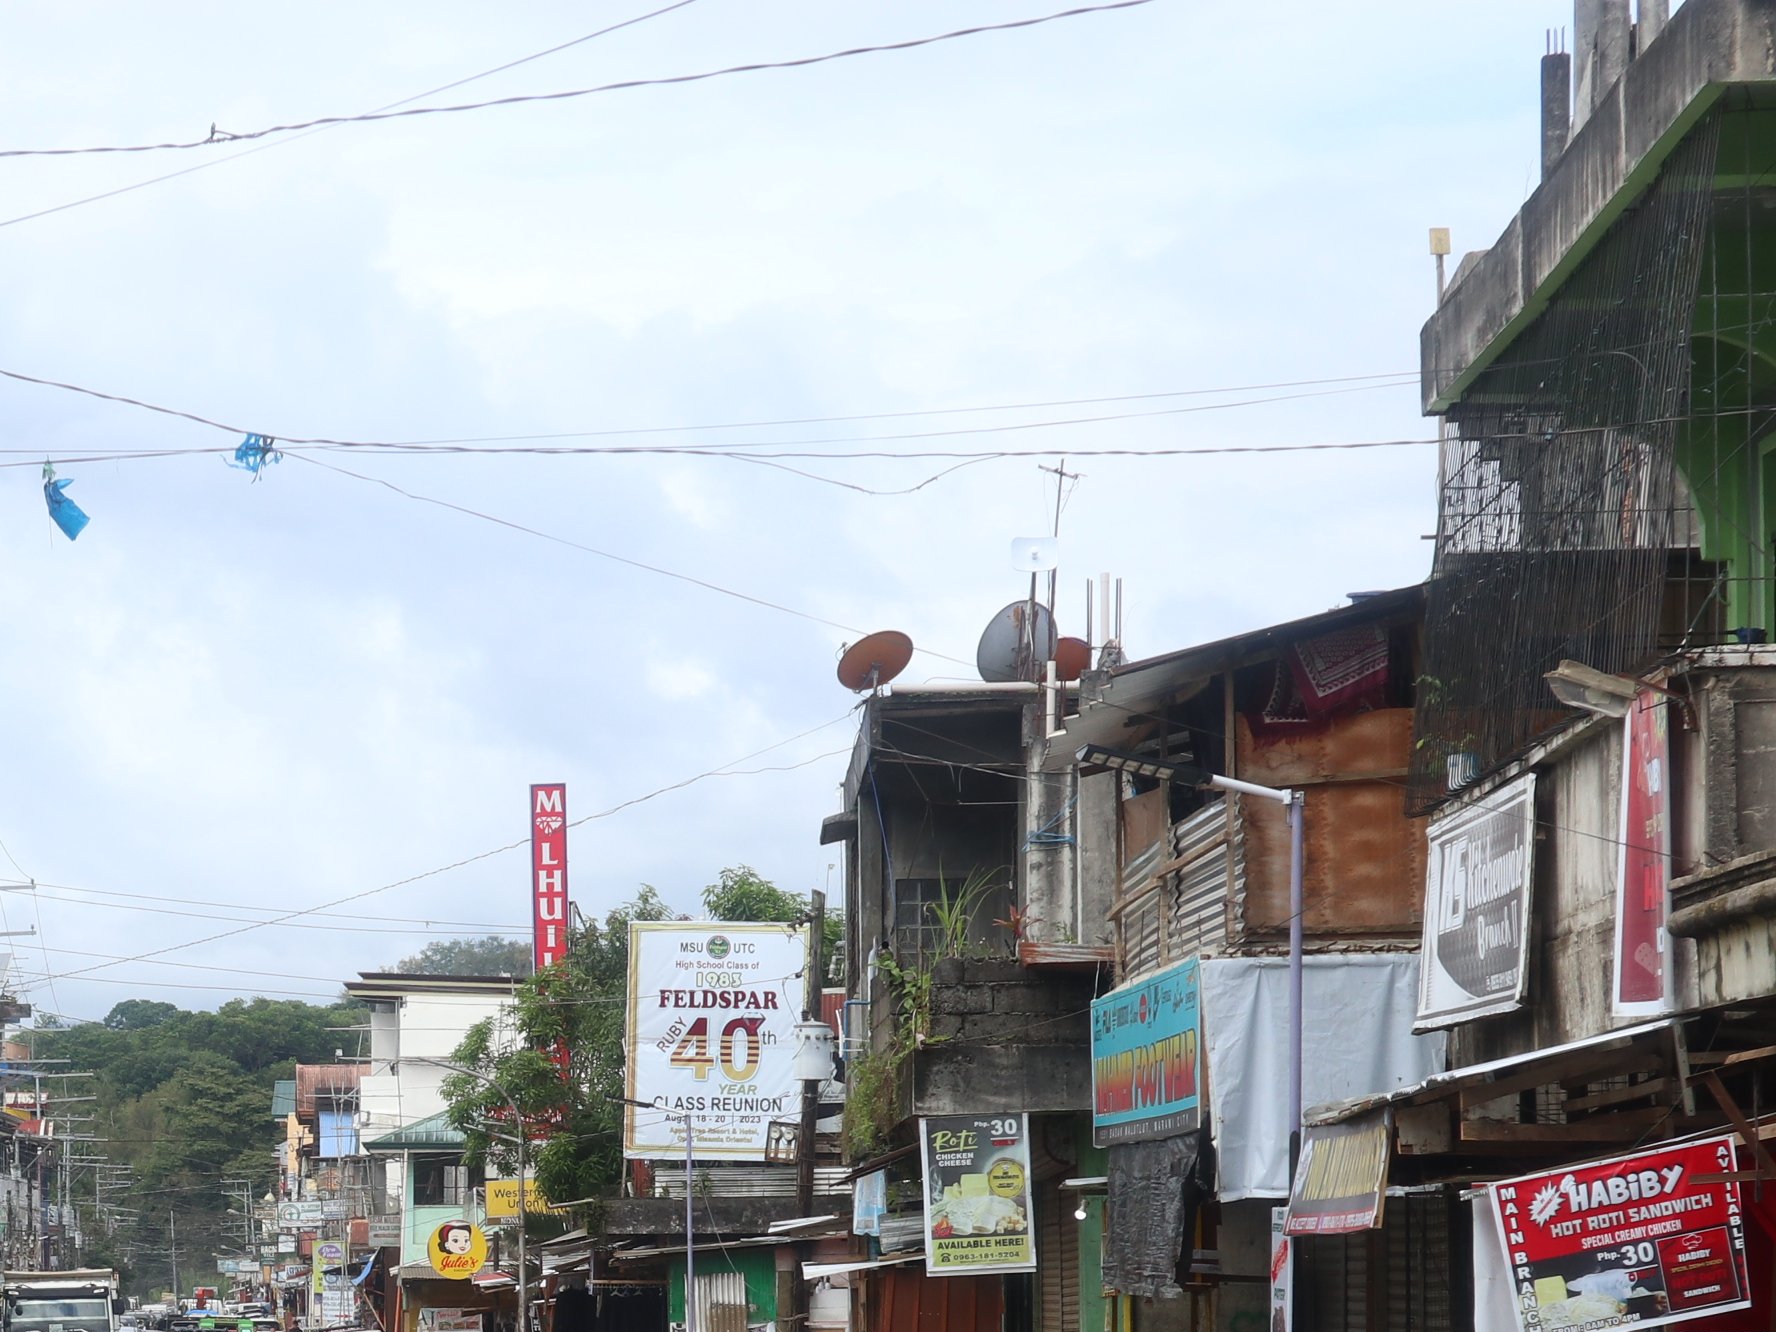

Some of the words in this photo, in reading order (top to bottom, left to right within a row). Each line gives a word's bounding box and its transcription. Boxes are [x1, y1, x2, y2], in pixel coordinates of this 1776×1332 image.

[535, 790, 563, 813] M
[1478, 905, 1512, 960] Branch
[680, 942, 704, 953] MSU
[733, 943, 756, 954] UTC
[675, 960, 695, 971] High
[696, 961, 724, 970] School
[726, 961, 749, 970] Class
[750, 961, 760, 970] of
[695, 972, 743, 988] 1983
[658, 989, 779, 1010] FELDSPAR
[655, 1015, 688, 1054] RUBY
[669, 1016, 762, 1082] 40
[761, 1030, 778, 1046] th
[1135, 1028, 1197, 1110] FOOTWEAR
[718, 1084, 759, 1096] YEAR
[653, 1096, 706, 1112] CLASS
[710, 1096, 783, 1113] REUNION
[714, 1115, 726, 1123] 20
[739, 1115, 762, 1124] 2023
[990, 1118, 1018, 1136] 30
[930, 1129, 978, 1151] Roti
[935, 1151, 975, 1161] CHICKEN
[938, 1158, 973, 1168] CHEESE
[493, 1187, 541, 1199] Wesern
[1716, 1145, 1745, 1251] AVILABLE
[507, 1198, 539, 1210] Unon
[1499, 1186, 1525, 1246] MAIN
[1551, 1220, 1583, 1240] HOT
[1587, 1210, 1625, 1233] ROTI
[1629, 1192, 1713, 1223] SANDWICH
[1580, 1231, 1615, 1251] SPECIAL
[1614, 1225, 1647, 1245] CREAMY
[1647, 1218, 1683, 1238] CHICKEN
[937, 1239, 992, 1251] AVAILABLE
[994, 1236, 1025, 1248] HERE!
[1596, 1250, 1621, 1264] Php.
[1620, 1240, 1655, 1268] 30
[1677, 1248, 1712, 1263] HABIBY
[439, 1255, 479, 1272] Julie's
[1683, 1284, 1722, 1298] SANDWICH
[1585, 1320, 1606, 1332] 8AM
[1607, 1317, 1620, 1329] TO
[1621, 1312, 1642, 1326] 4PM
